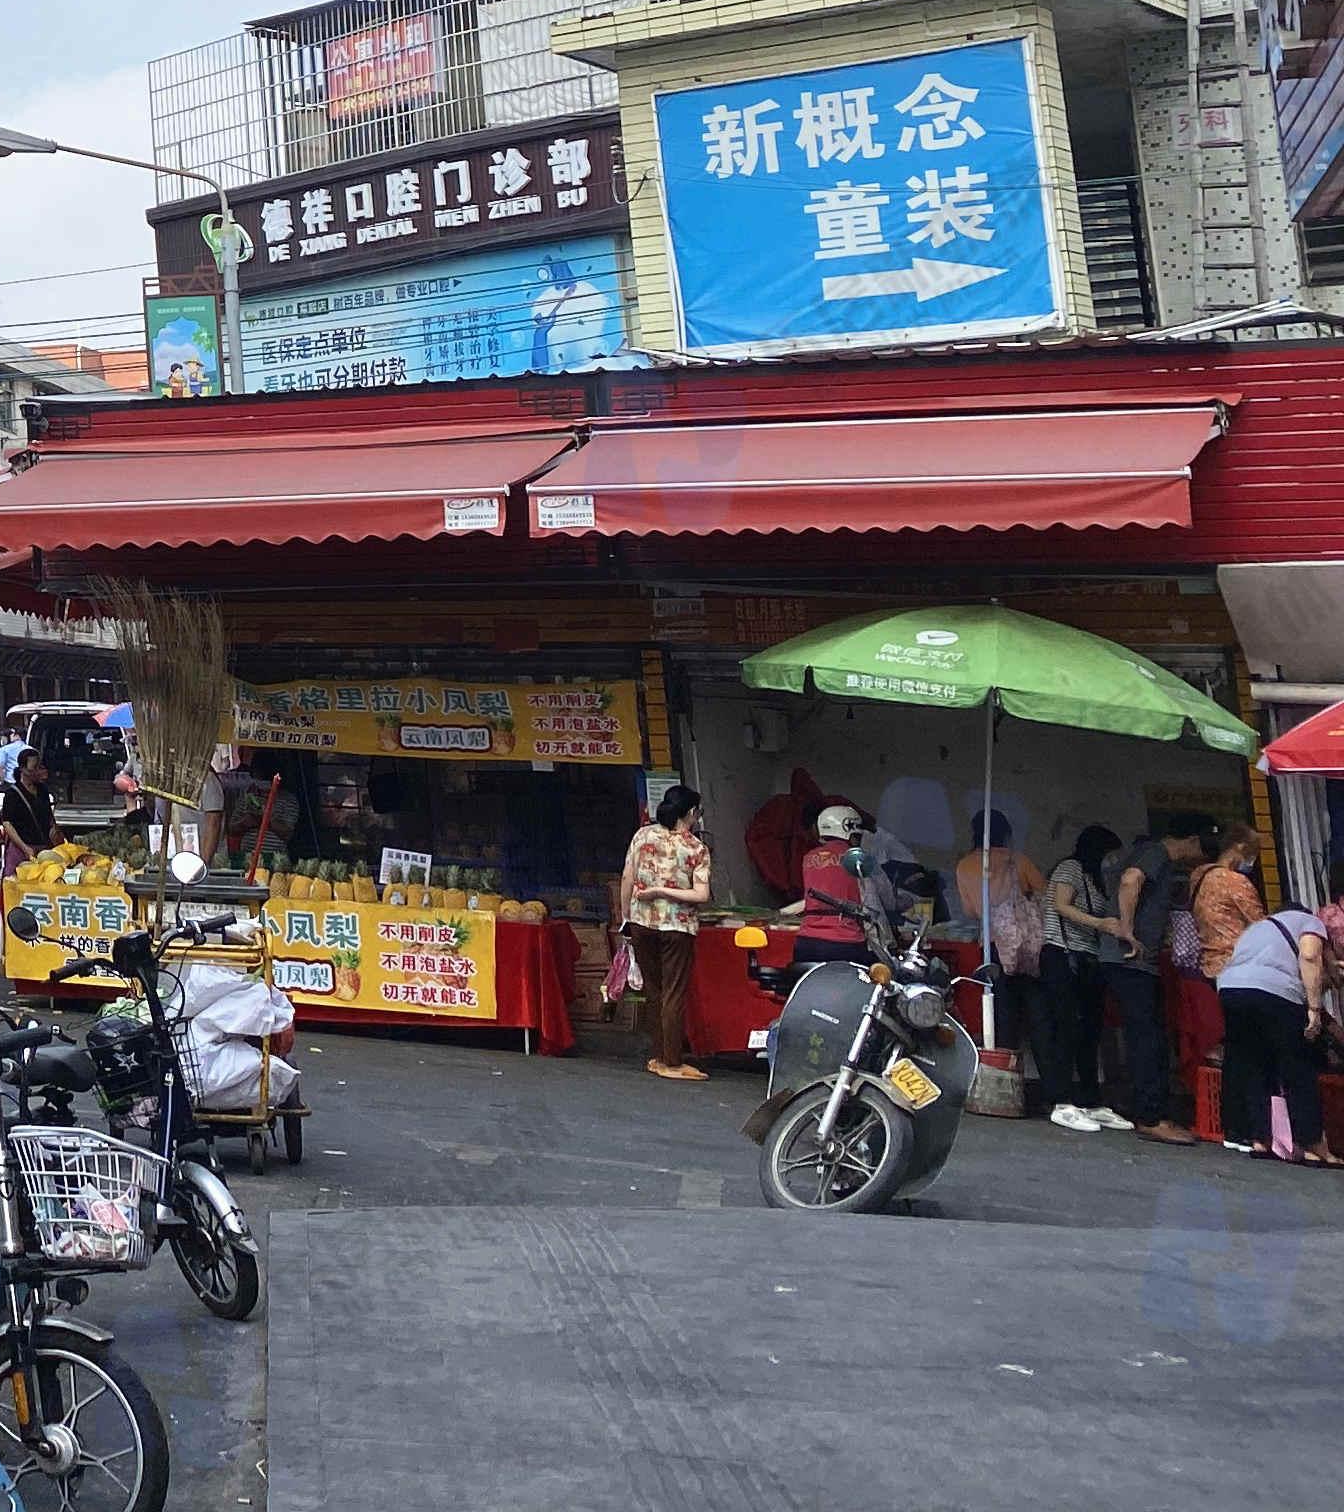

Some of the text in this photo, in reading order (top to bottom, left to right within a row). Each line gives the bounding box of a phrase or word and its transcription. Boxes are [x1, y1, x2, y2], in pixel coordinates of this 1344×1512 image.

[701, 72, 987, 180] 新概念
[262, 139, 592, 244] 德祥口腔门诊部
[434, 204, 480, 228] MEN
[488, 194, 542, 220] ZHEN
[557, 187, 588, 209] BU
[804, 166, 996, 261] 童装
[262, 327, 368, 366] 医保定点单位
[527, 692, 601, 708] 不用削皮
[531, 717, 622, 733] 不用泡盐水
[403, 726, 487, 748] 云南凤梨
[535, 741, 623, 756] 切开就能吃
[379, 922, 455, 944] 不用削皮
[381, 953, 476, 975] 不用泡盐水
[382, 983, 477, 1006] 切开就能吃
